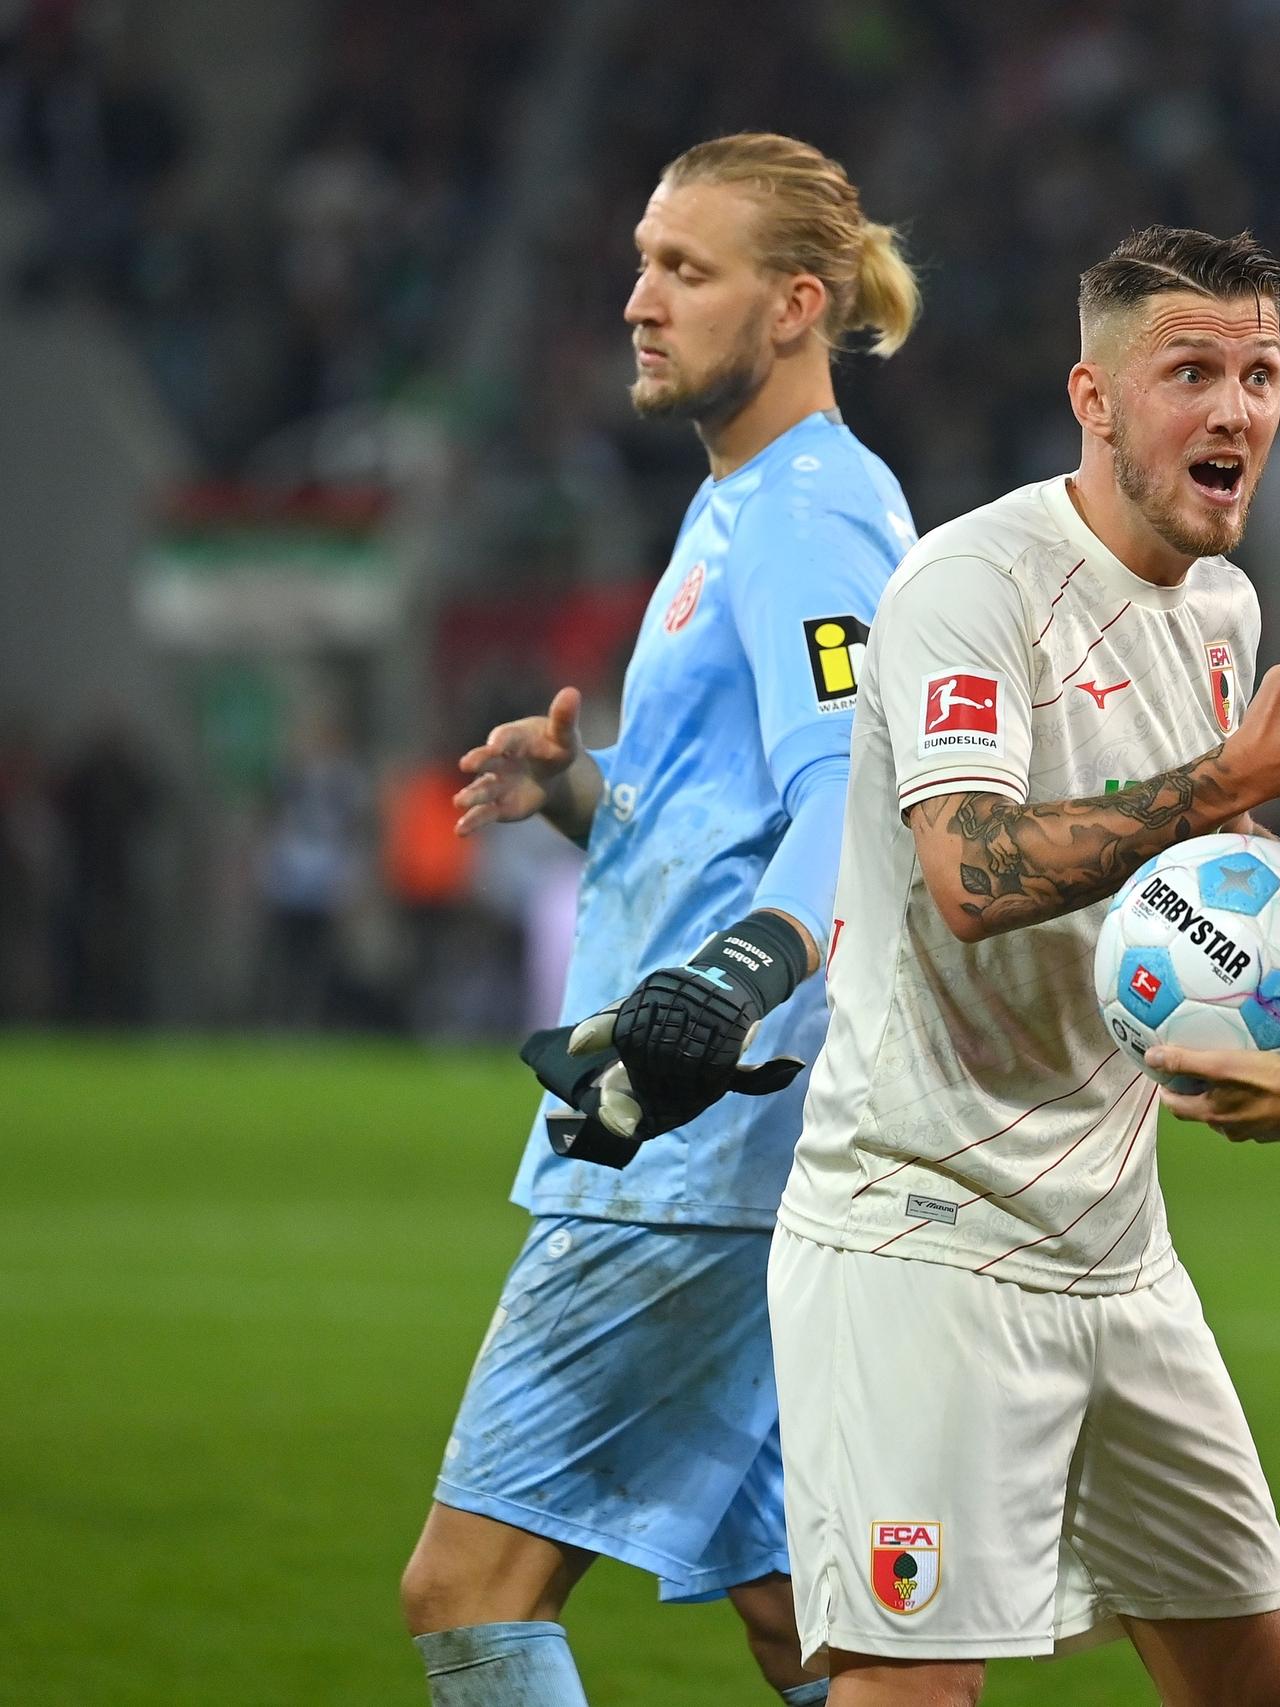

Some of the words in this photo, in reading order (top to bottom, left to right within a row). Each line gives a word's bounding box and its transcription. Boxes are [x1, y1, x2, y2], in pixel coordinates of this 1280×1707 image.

[924, 735, 997, 749] BUNDESLIGA
[1140, 877, 1251, 980] DERBYSTAR
[722, 947, 760, 972] Robin
[724, 936, 774, 967] Zentner
